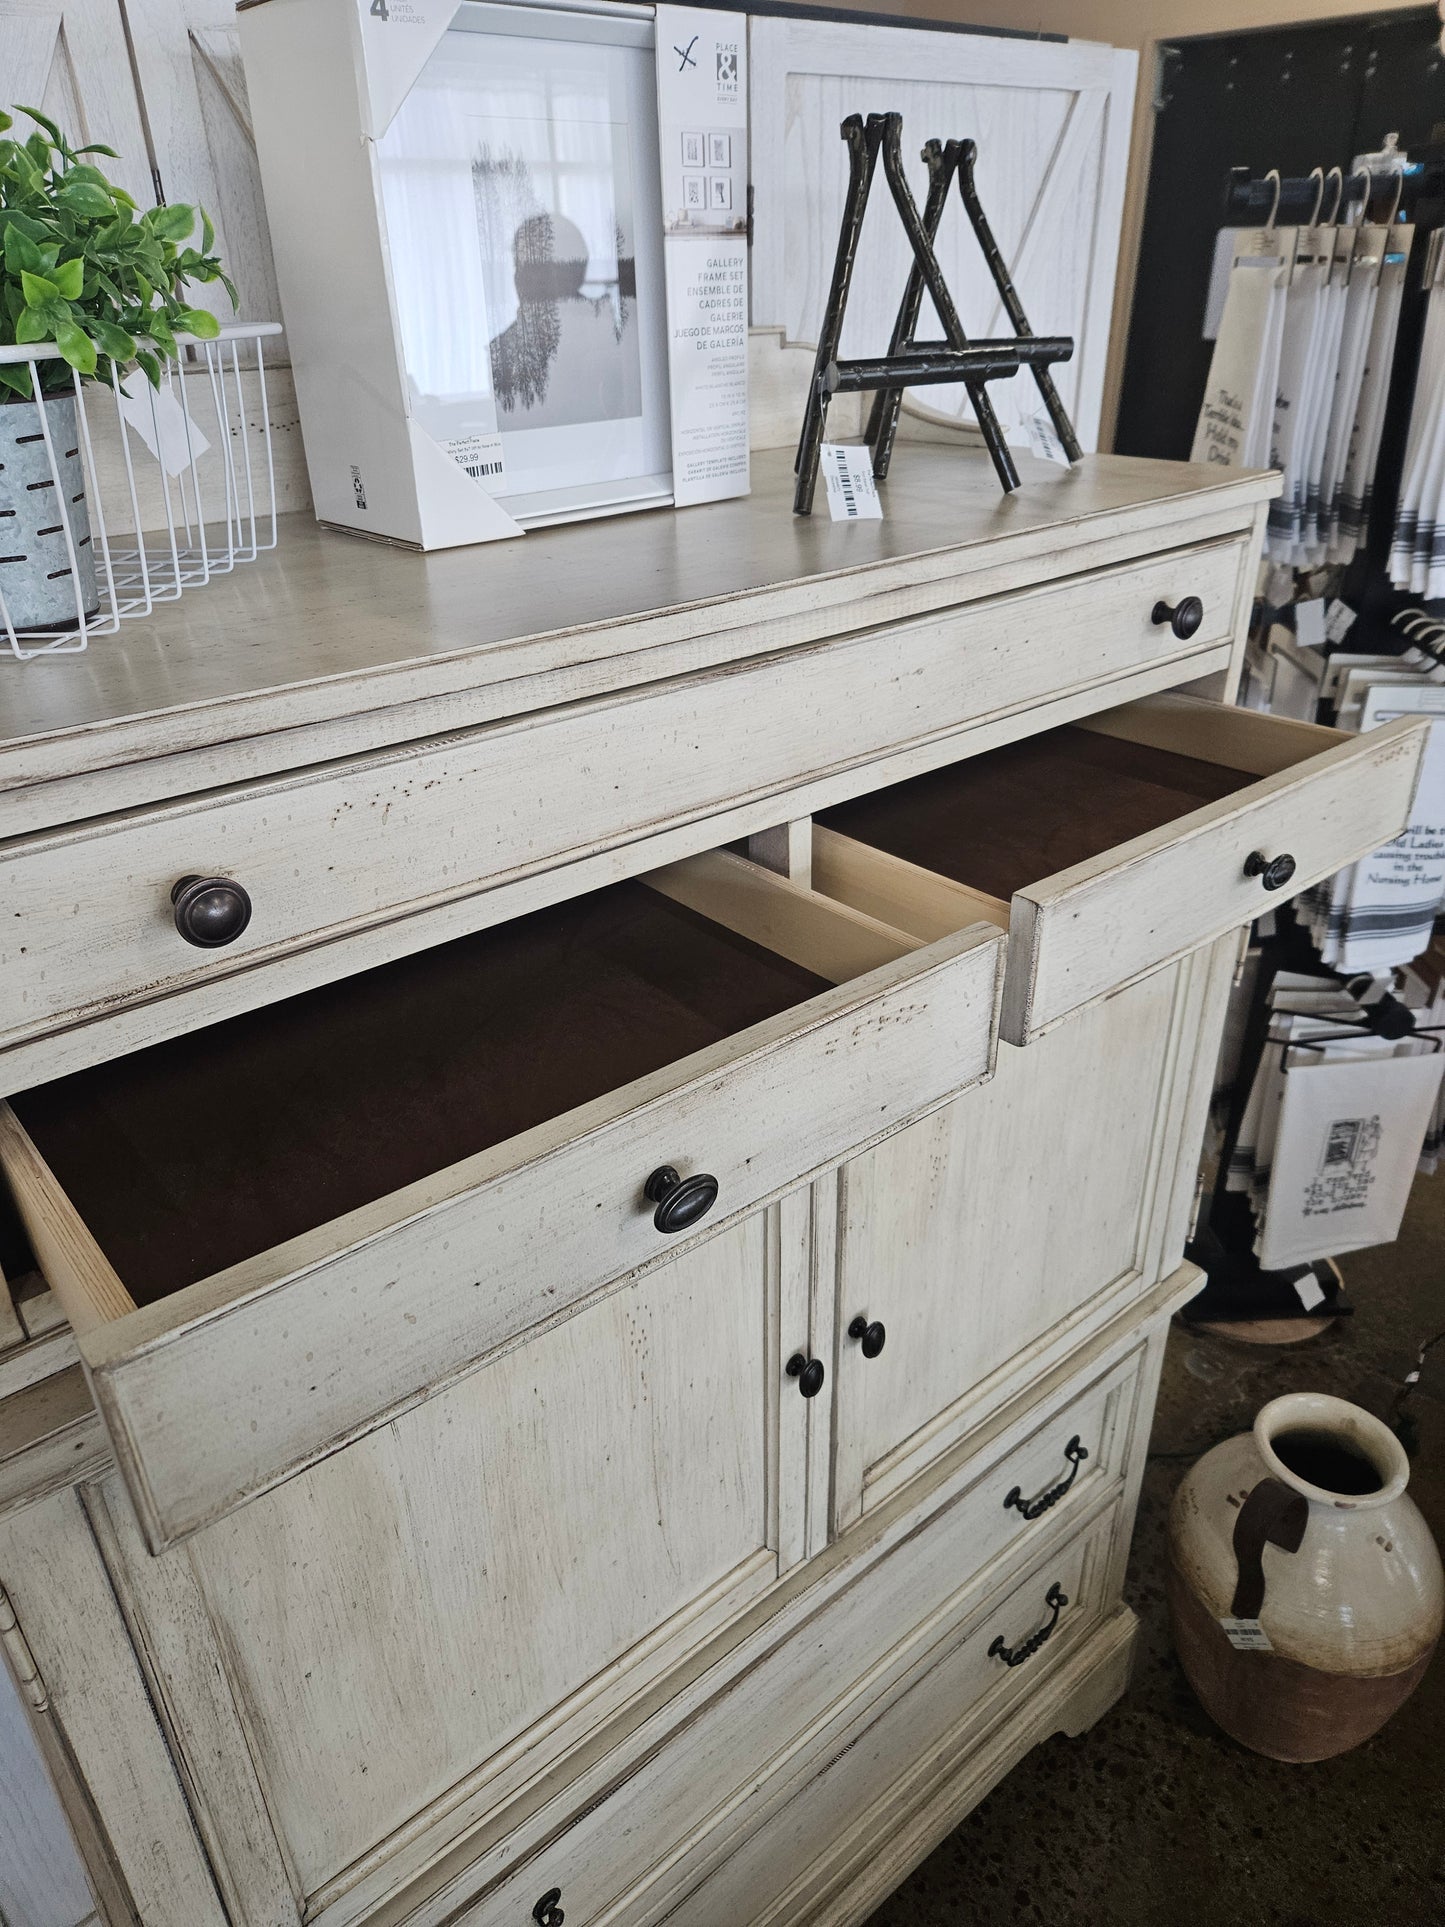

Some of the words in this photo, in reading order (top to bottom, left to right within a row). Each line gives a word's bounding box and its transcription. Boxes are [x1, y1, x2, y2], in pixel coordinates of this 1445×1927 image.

[370, 0, 390, 21] 4
[391, 15, 425, 24] UNIDADES
[716, 42, 738, 52] PLACE
[717, 53, 738, 82] &
[717, 83, 738, 92] TIME
[706, 258, 744, 268] GALLERY
[698, 272, 728, 282] FRAME
[730, 271, 744, 280] SET
[687, 285, 732, 296] ENSEMBLE
[733, 284, 744, 294] DE
[699, 298, 731, 309] CADRES
[734, 298, 744, 307] DE
[710, 312, 744, 322] GALERIE
[674, 328, 700, 338] JUEGO
[701, 327, 711, 336] DE
[713, 324, 744, 335] MARCOS
[697, 341, 708, 350] DE
[710, 337, 744, 348] GALERÍA
[455, 453, 478, 464] $29.99
[1425, 825, 1436, 835] be
[1410, 837, 1444, 848] Ladies
[1407, 863, 1423, 872] the
[1368, 873, 1410, 886] Nursing
